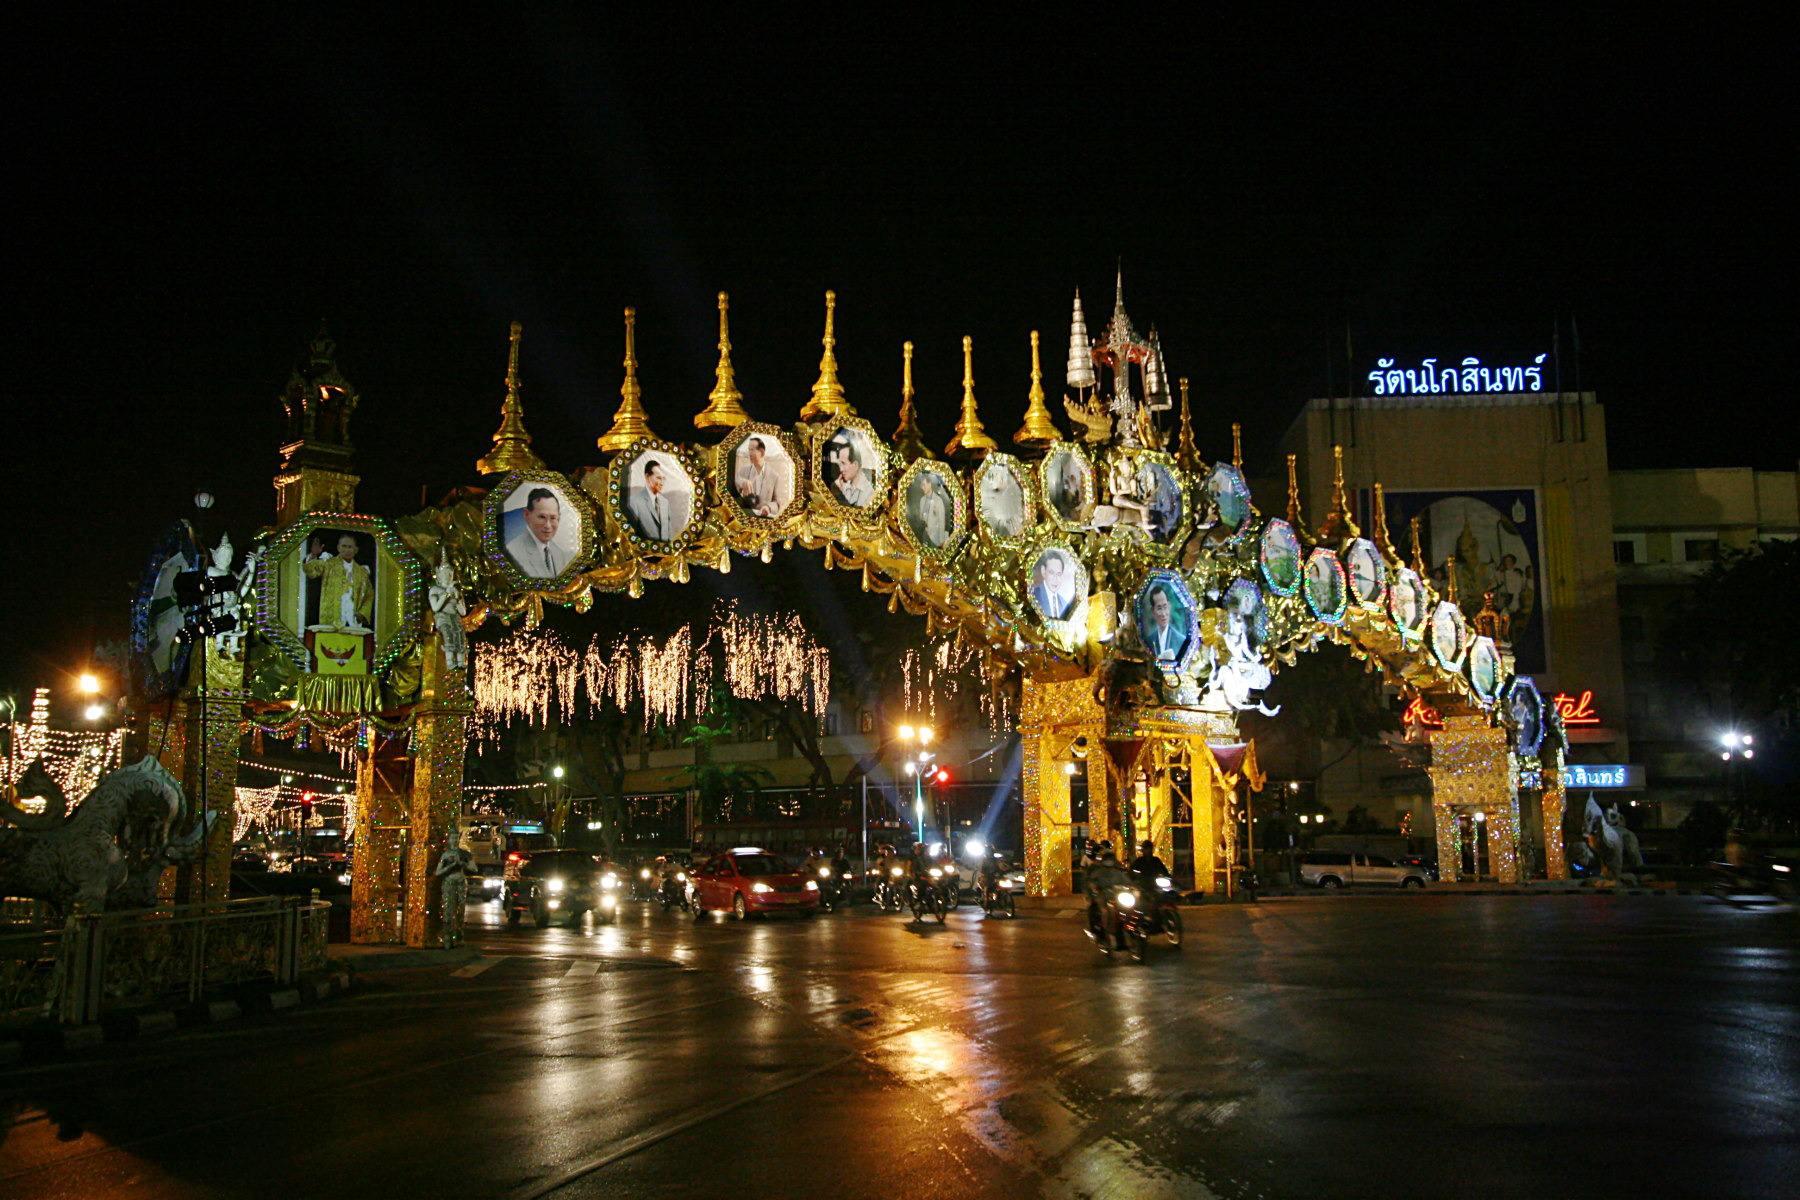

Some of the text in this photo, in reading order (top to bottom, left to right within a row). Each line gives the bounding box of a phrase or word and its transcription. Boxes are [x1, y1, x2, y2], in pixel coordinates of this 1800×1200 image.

[1367, 353, 1546, 395] รัตนโกสินทร์
